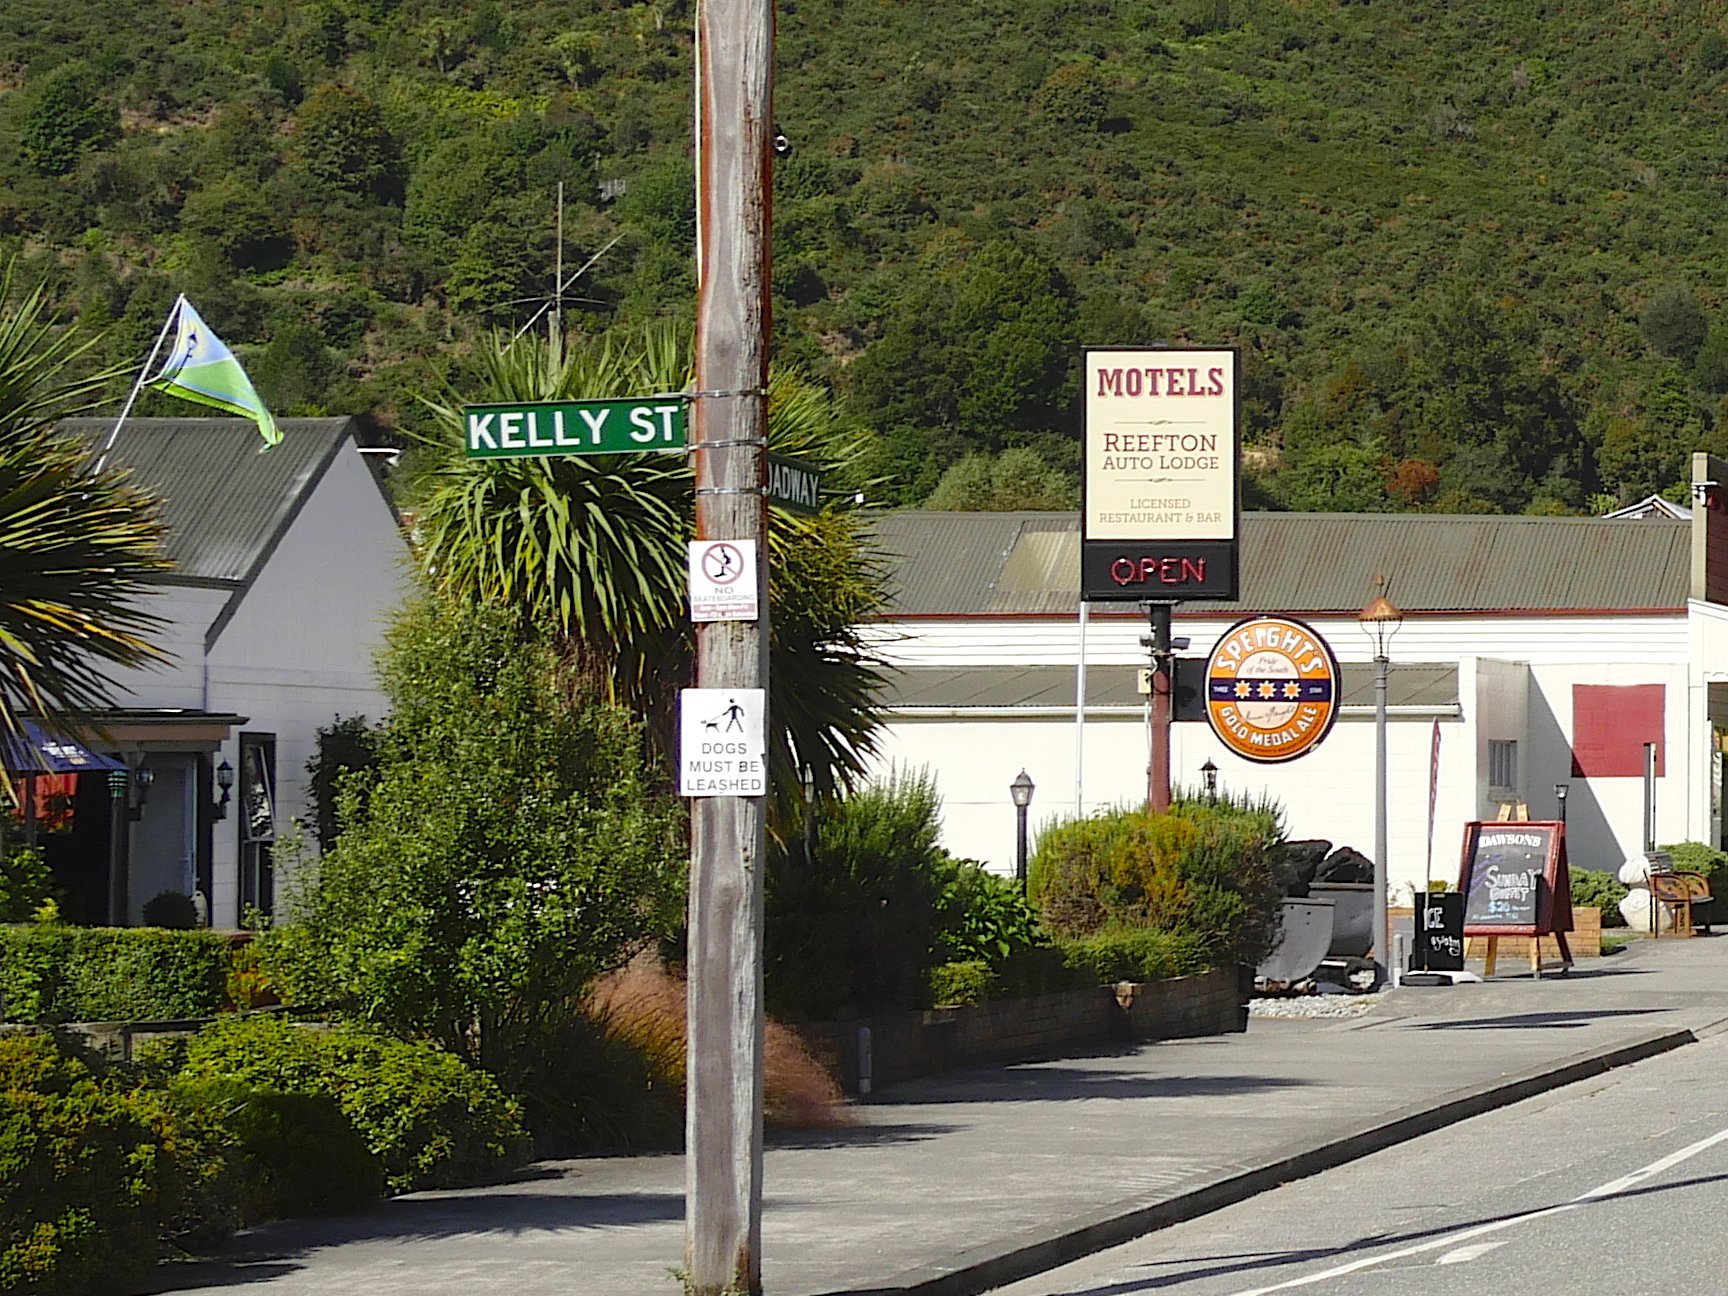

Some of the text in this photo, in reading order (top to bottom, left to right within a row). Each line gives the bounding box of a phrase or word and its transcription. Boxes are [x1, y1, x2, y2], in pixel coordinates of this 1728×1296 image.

[1097, 367, 1224, 398] MOTELS
[469, 405, 679, 450] KELLY ST
[1102, 455, 1219, 470] AUTO LODGE
[1130, 499, 1191, 509] LICENSED
[1099, 512, 1182, 523] RESTAURANT
[1197, 512, 1222, 523] BAR
[1110, 556, 1206, 586] OPEN
[1221, 706, 1248, 739] GOLD
[1250, 728, 1300, 747] MEDAL
[1297, 706, 1317, 731] ALE
[702, 743, 747, 754] DOGS
[690, 761, 759, 772] MUST BE
[687, 779, 761, 790] LEASHED
[1479, 834, 1541, 848] DAWSONS
